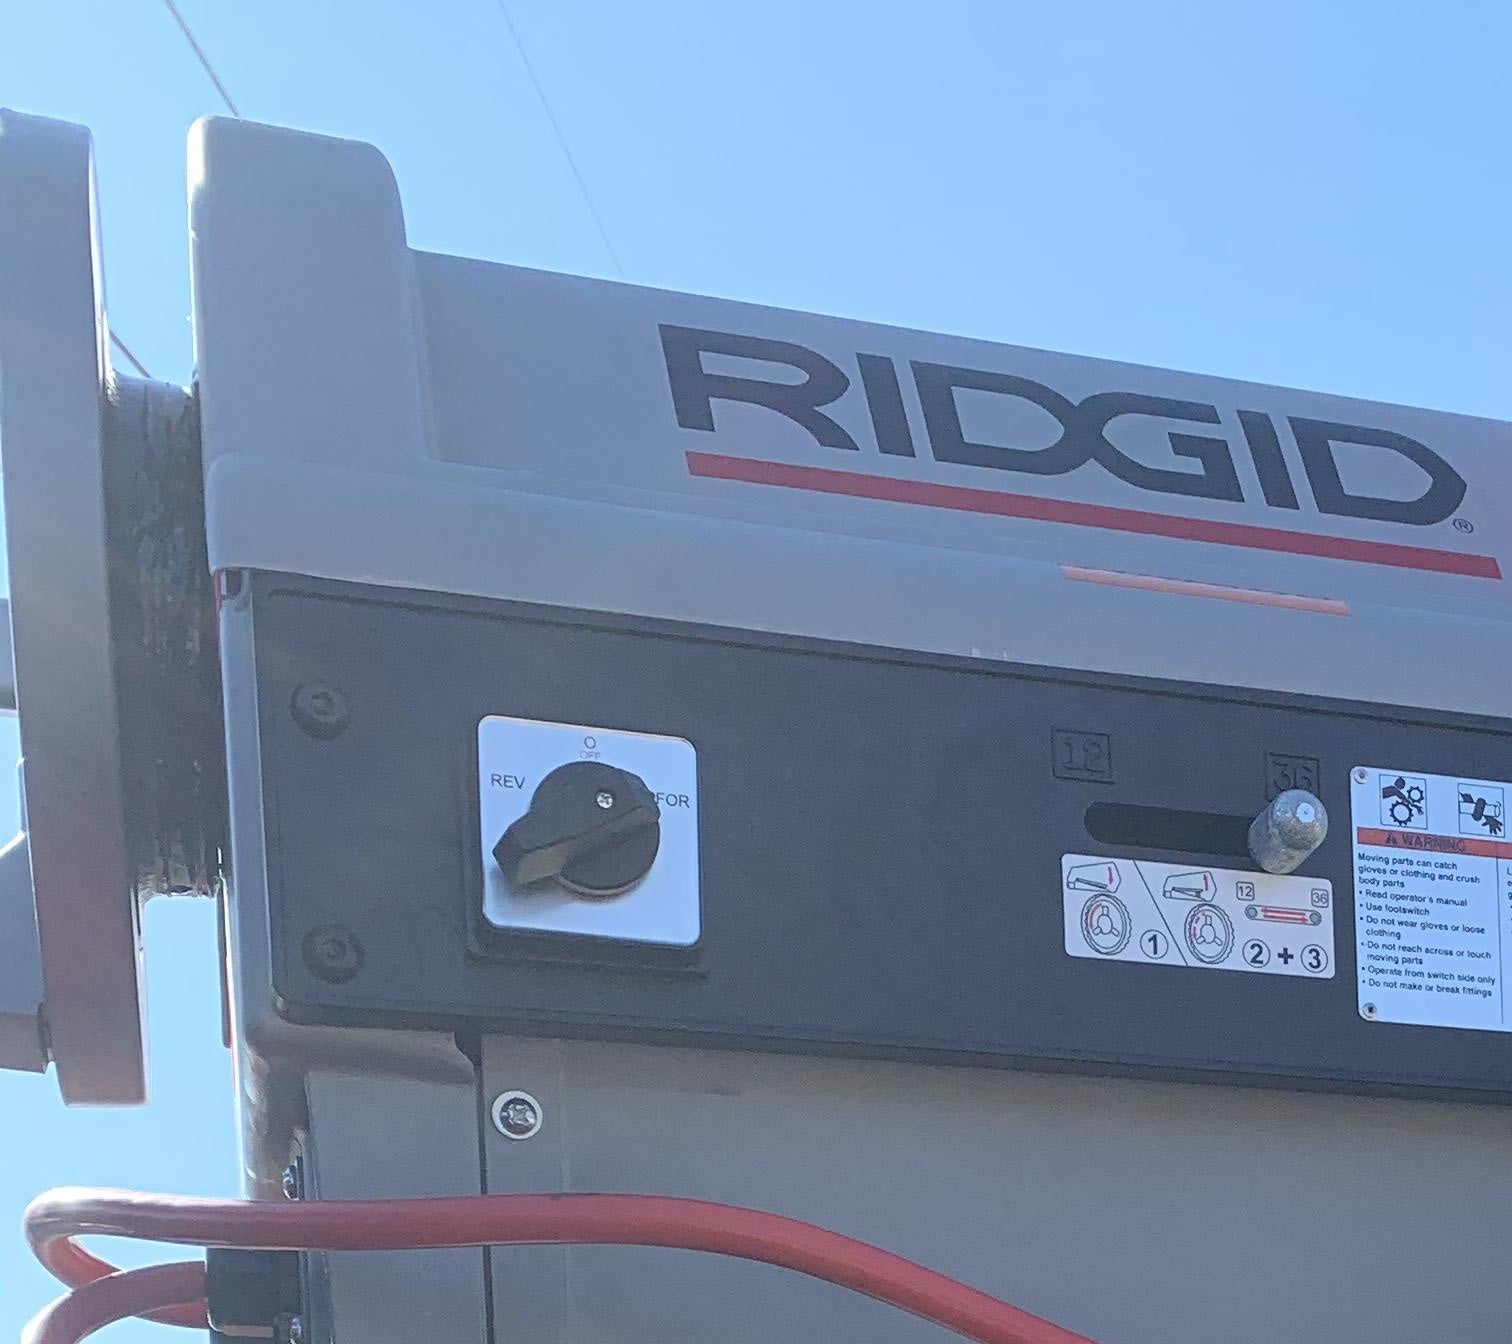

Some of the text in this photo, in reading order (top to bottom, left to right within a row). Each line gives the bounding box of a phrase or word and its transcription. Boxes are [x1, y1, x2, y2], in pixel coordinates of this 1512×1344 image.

[659, 324, 1469, 528] RIDGID
[579, 751, 601, 760] OFF
[491, 773, 525, 789] REV
[657, 792, 690, 808] FOR
[1402, 833, 1466, 852] WARNING
[1358, 852, 1389, 864] Moving
[1392, 857, 1413, 866] parts
[1435, 862, 1457, 870] catch
[1359, 865, 1386, 875] gloves
[1401, 870, 1435, 880] clothing
[1359, 877, 1404, 888] body parts
[1239, 885, 1252, 897] 12
[1313, 892, 1328, 904] 36
[1365, 889, 1387, 899] Read
[1436, 897, 1467, 906] manual
[1366, 903, 1430, 915] Use footswitch
[1366, 915, 1378, 924] Do
[1381, 918, 1395, 926] not
[1421, 922, 1448, 931] gloves
[1462, 925, 1485, 934] loose
[1366, 928, 1400, 940] clothing
[1148, 934, 1157, 955] 1
[1368, 941, 1379, 949] Do
[1382, 943, 1396, 951] not
[1399, 944, 1422, 953] reach
[1425, 948, 1453, 956] across
[1468, 950, 1491, 959] touch
[1250, 944, 1321, 969] 2 3
[1367, 954, 1423, 965] moving parts
[1368, 965, 1495, 986] Operate from switch side only
[1369, 978, 1380, 987] Do
[1383, 980, 1397, 988] not
[1400, 982, 1422, 990] make
[1437, 985, 1459, 994] break
[1463, 986, 1492, 998] fittings
